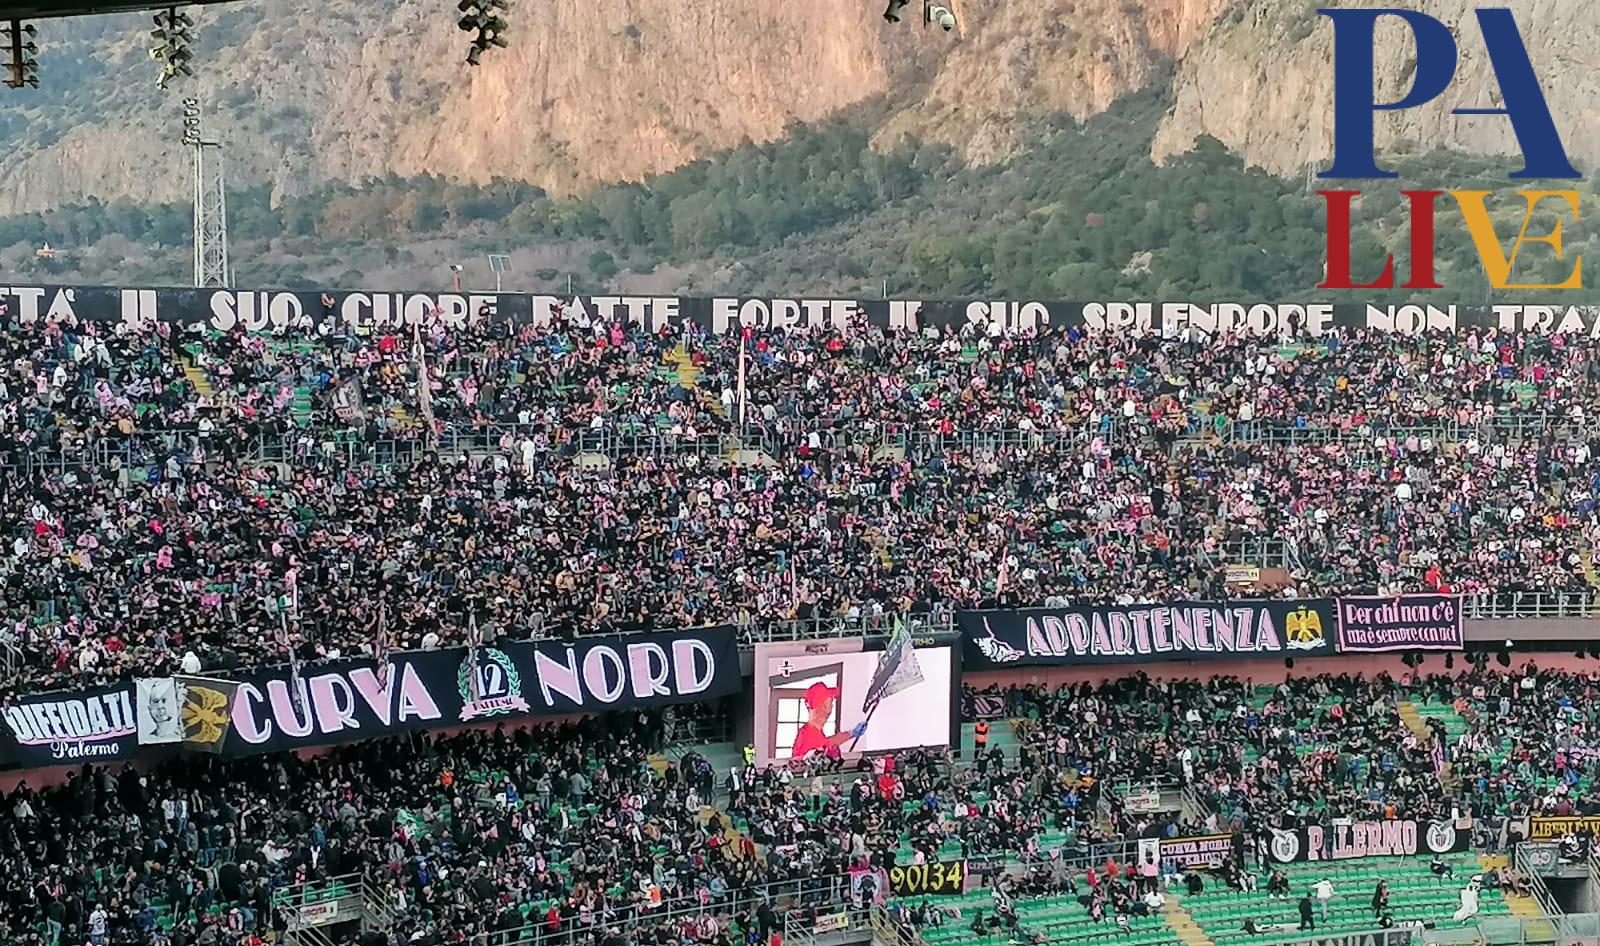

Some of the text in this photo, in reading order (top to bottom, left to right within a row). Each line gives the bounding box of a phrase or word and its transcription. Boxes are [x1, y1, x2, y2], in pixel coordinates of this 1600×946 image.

[210, 291, 302, 331] SUO
[341, 294, 497, 332] CUORE
[533, 296, 679, 335] BATTE
[713, 299, 857, 336] FORTE
[966, 302, 1049, 334] SUO
[1082, 303, 1333, 338] SPLENDORE
[1366, 305, 1456, 337] NON
[1492, 305, 1600, 340] TRA
[1346, 600, 1454, 624] Per chi non c'è
[1026, 607, 1281, 656] APPARTENENZA
[1376, 628, 1418, 643] sempre
[1419, 627, 1437, 642] con
[1437, 625, 1457, 641] noi
[230, 639, 715, 744] CURVA NORD
[477, 663, 507, 697] 12
[1, 690, 136, 741] DIFFIDATI
[50, 740, 119, 758] Palermo
[1161, 839, 1231, 855] CURVA NORD
[890, 861, 962, 893] 90134
